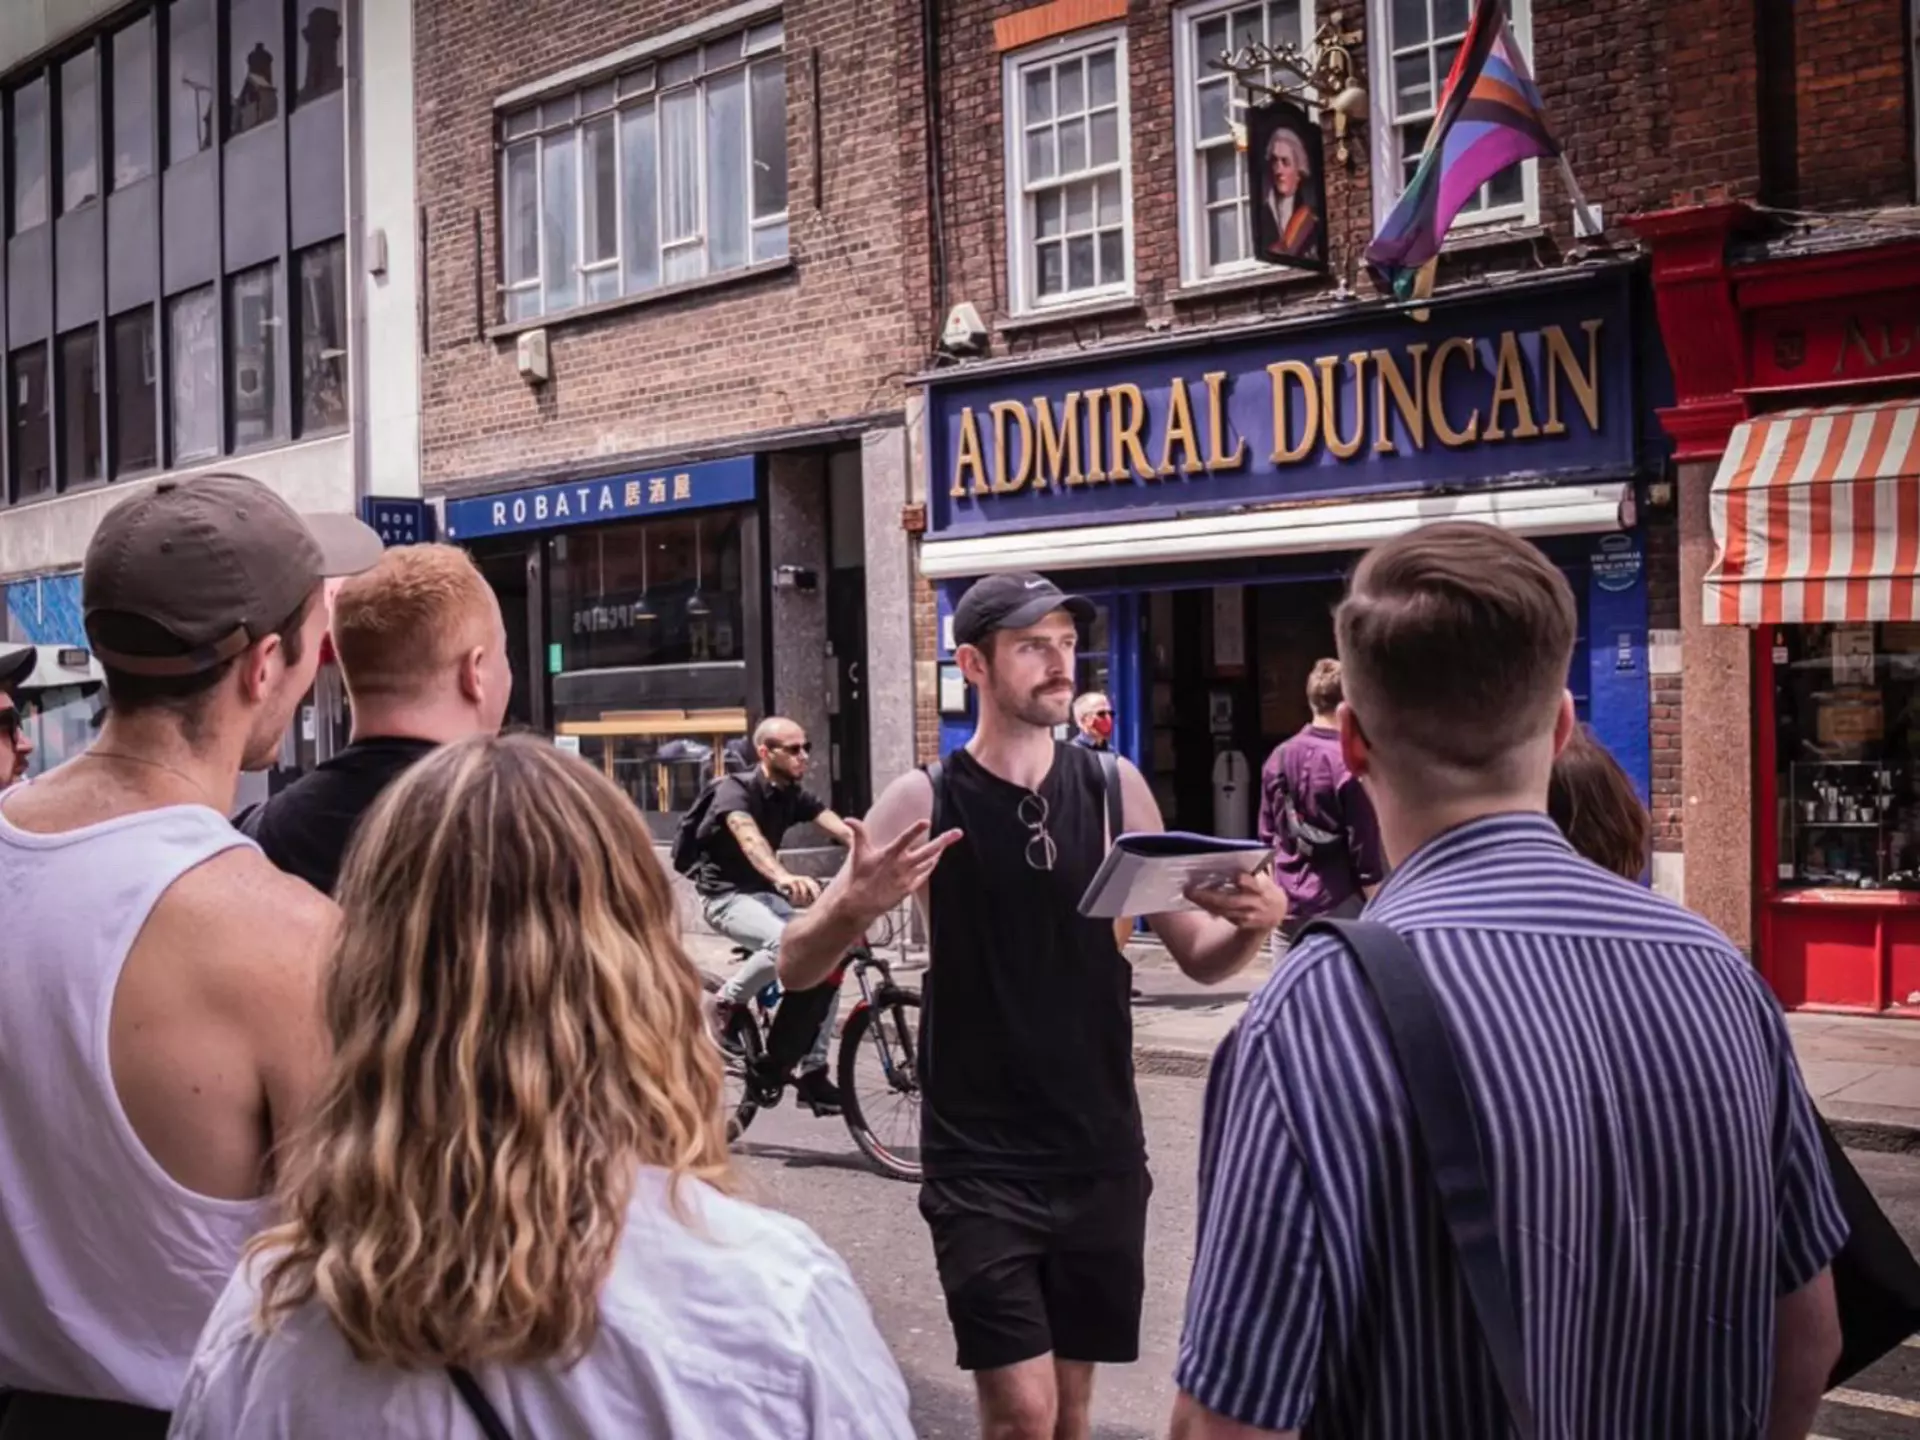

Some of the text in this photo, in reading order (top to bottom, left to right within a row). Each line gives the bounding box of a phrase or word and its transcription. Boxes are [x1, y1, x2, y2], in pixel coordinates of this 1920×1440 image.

[1832, 314, 1920, 374] AL
[949, 320, 1605, 497] ADMIRAL DUNCAN
[493, 485, 614, 526] ROBATA
